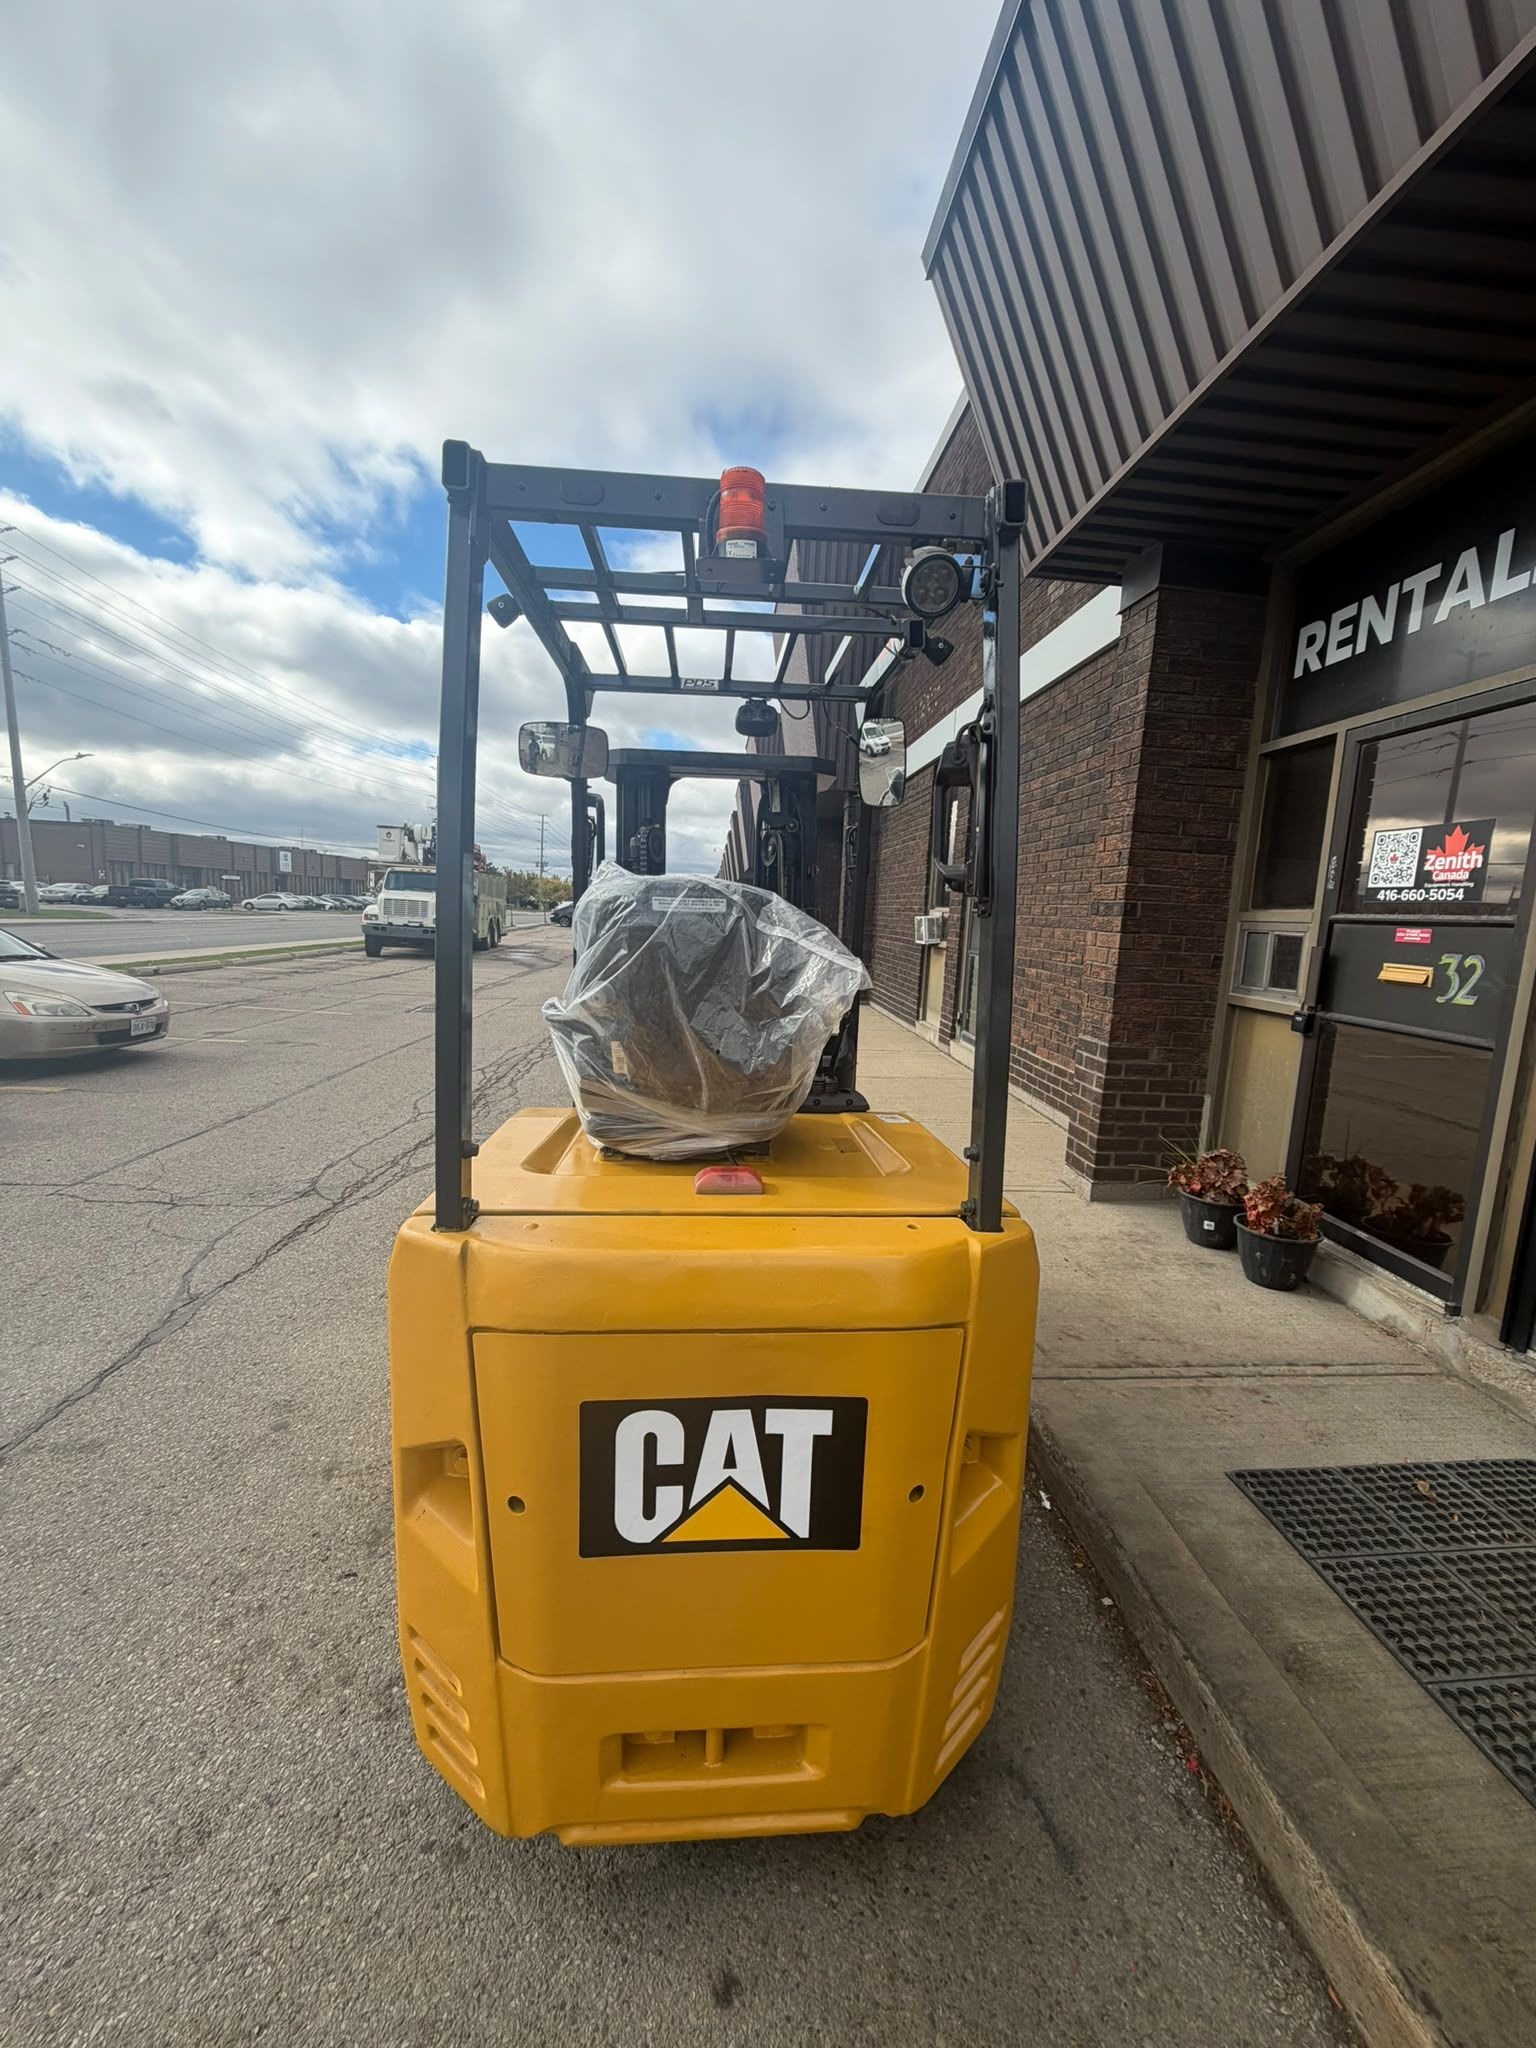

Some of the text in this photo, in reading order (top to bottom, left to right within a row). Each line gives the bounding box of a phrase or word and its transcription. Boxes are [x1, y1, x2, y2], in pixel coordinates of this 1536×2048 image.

[1293, 527, 1536, 679] RENTAL
[1424, 851, 1483, 870] Zenith
[1432, 870, 1469, 881] Canada
[1377, 888, 1464, 901] 416-660-5054
[1436, 953, 1485, 1005] 32
[614, 1408, 833, 1543] CAT
